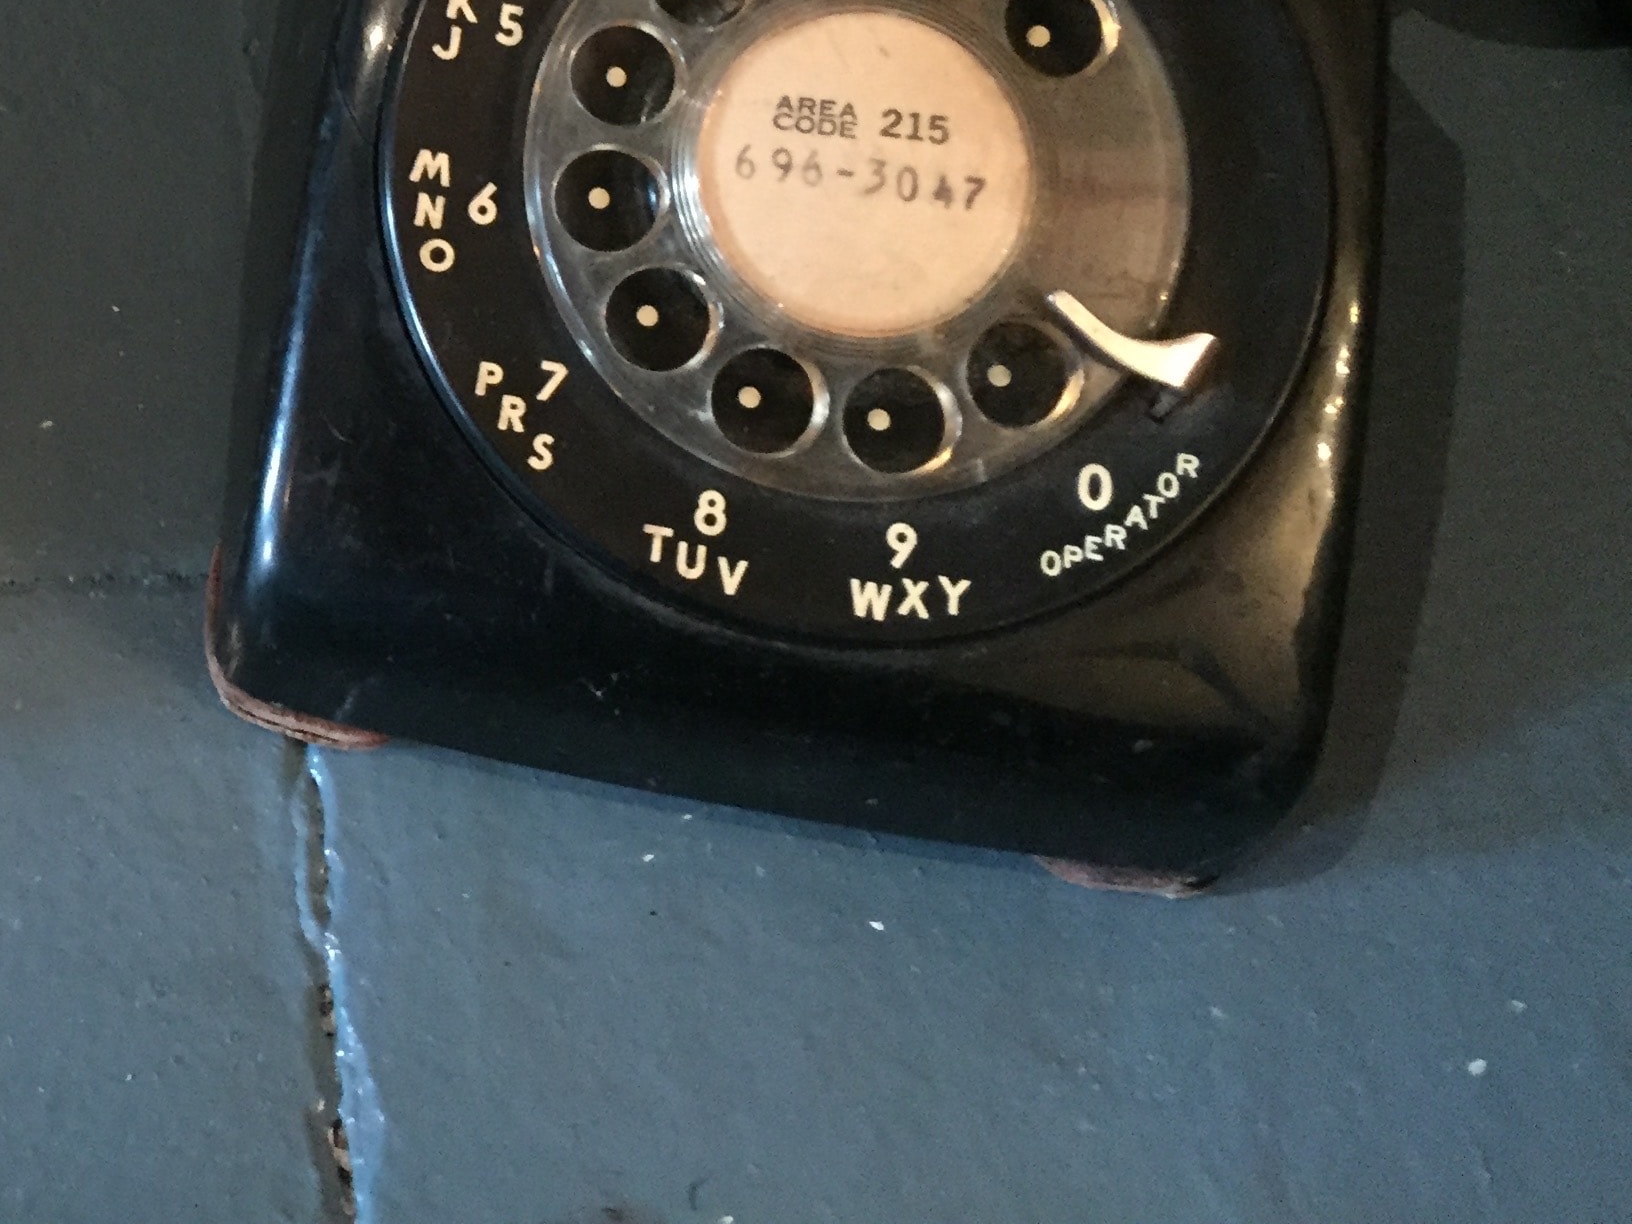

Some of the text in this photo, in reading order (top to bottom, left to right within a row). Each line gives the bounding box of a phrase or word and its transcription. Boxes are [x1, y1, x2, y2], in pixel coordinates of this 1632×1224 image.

[495, 3, 524, 47] 5
[773, 113, 858, 139] CODE
[776, 95, 857, 120] AREA
[880, 108, 950, 145] 215
[735, 144, 986, 210] 696-3047
[468, 182, 498, 225] 6
[536, 360, 568, 401] 7
[693, 490, 726, 536] 8
[1040, 453, 1200, 576] OPERATOR
[643, 524, 748, 596] TUV
[885, 522, 917, 569] 9
[850, 576, 970, 621] WXY
